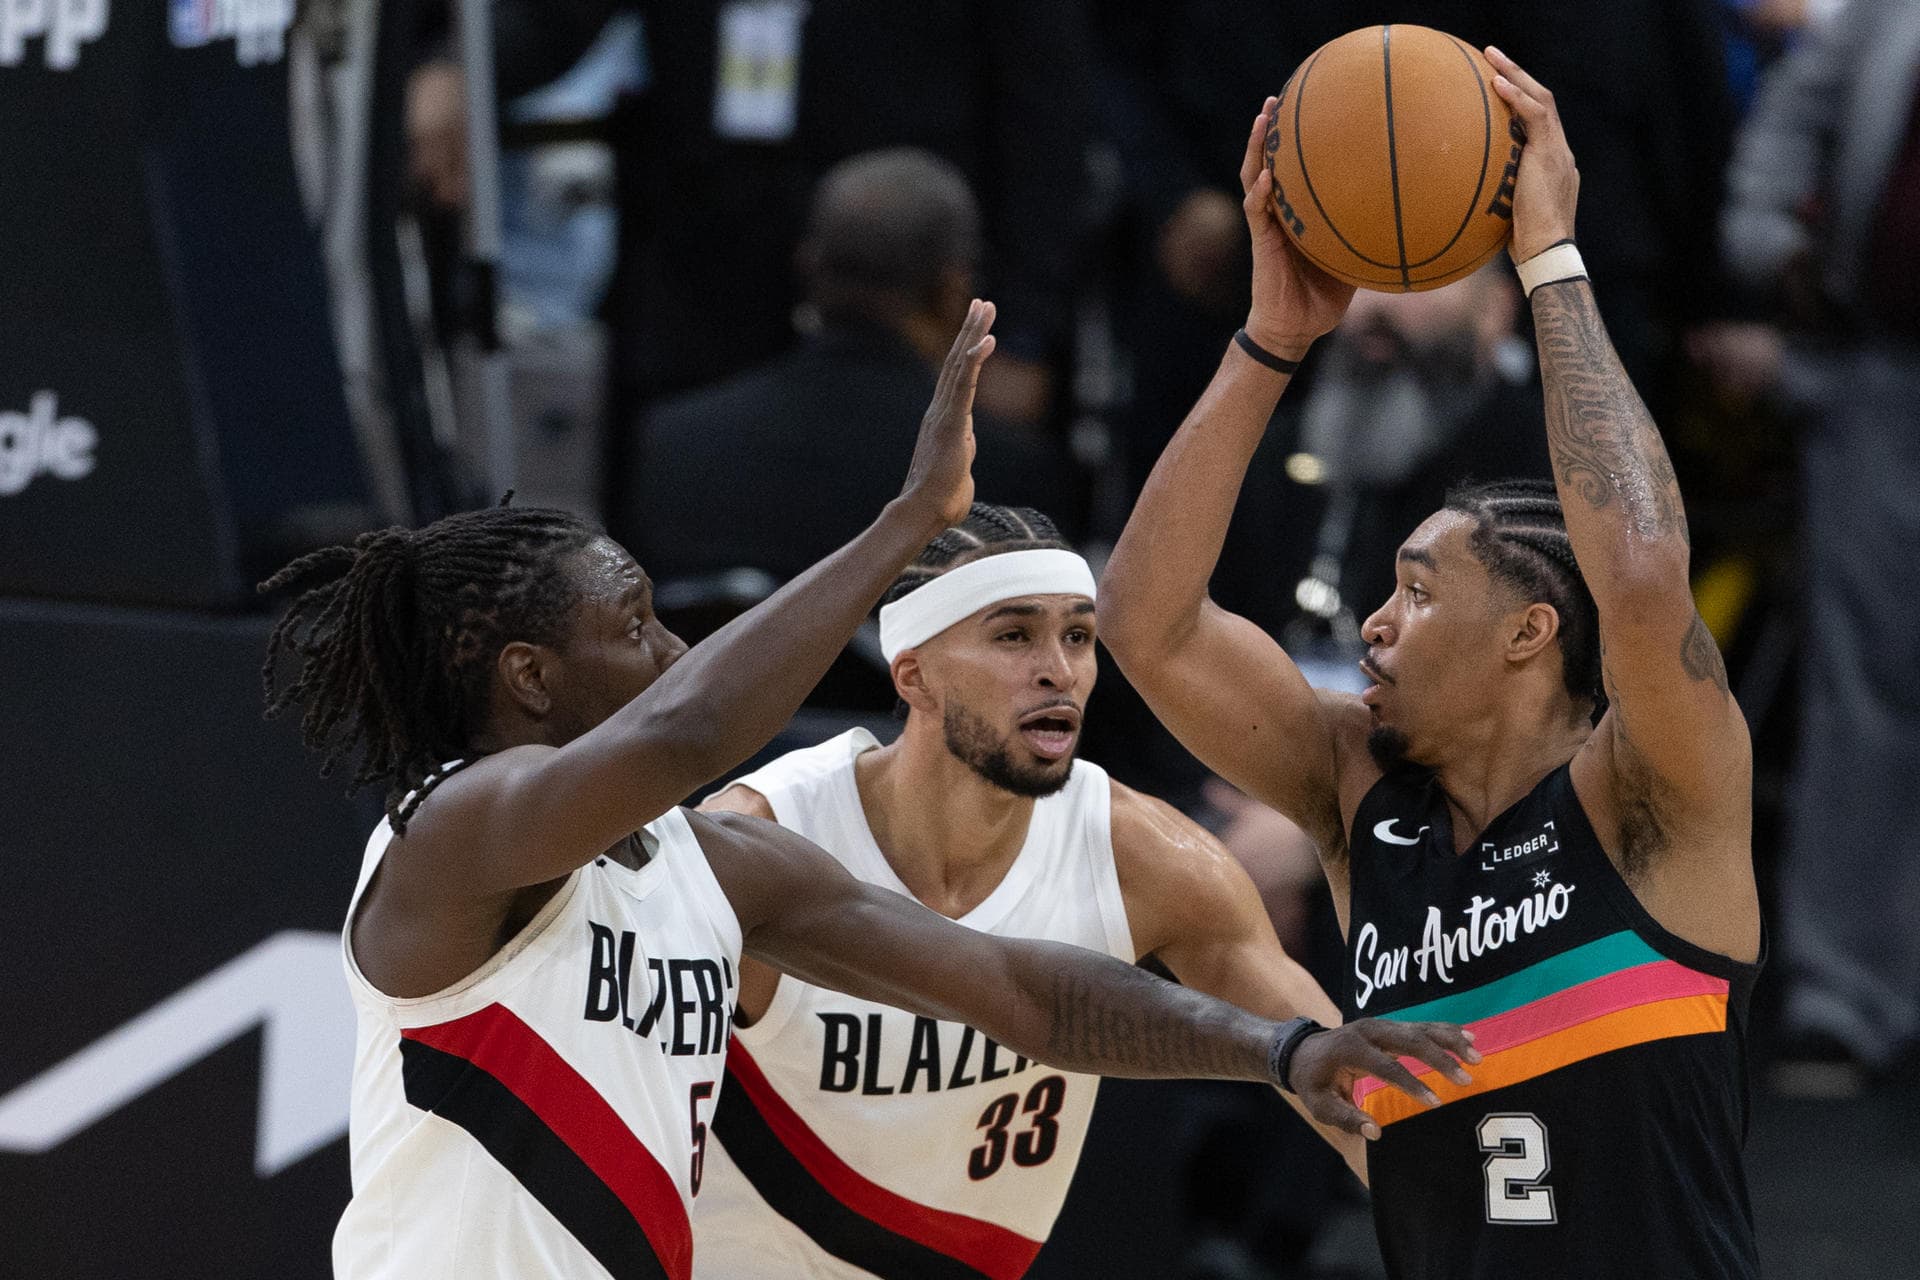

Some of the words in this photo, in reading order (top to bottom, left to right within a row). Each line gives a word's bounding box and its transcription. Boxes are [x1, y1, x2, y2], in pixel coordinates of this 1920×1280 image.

[1493, 834, 1548, 863] LEDGER
[584, 920, 733, 1056] BLZER
[1355, 922, 1409, 1010] San
[1413, 870, 1577, 984] Antonio
[816, 1012, 1041, 1096] BLAZ
[689, 1081, 715, 1198] 5
[967, 1074, 1067, 1182] 33
[1475, 1112, 1558, 1225] 2
